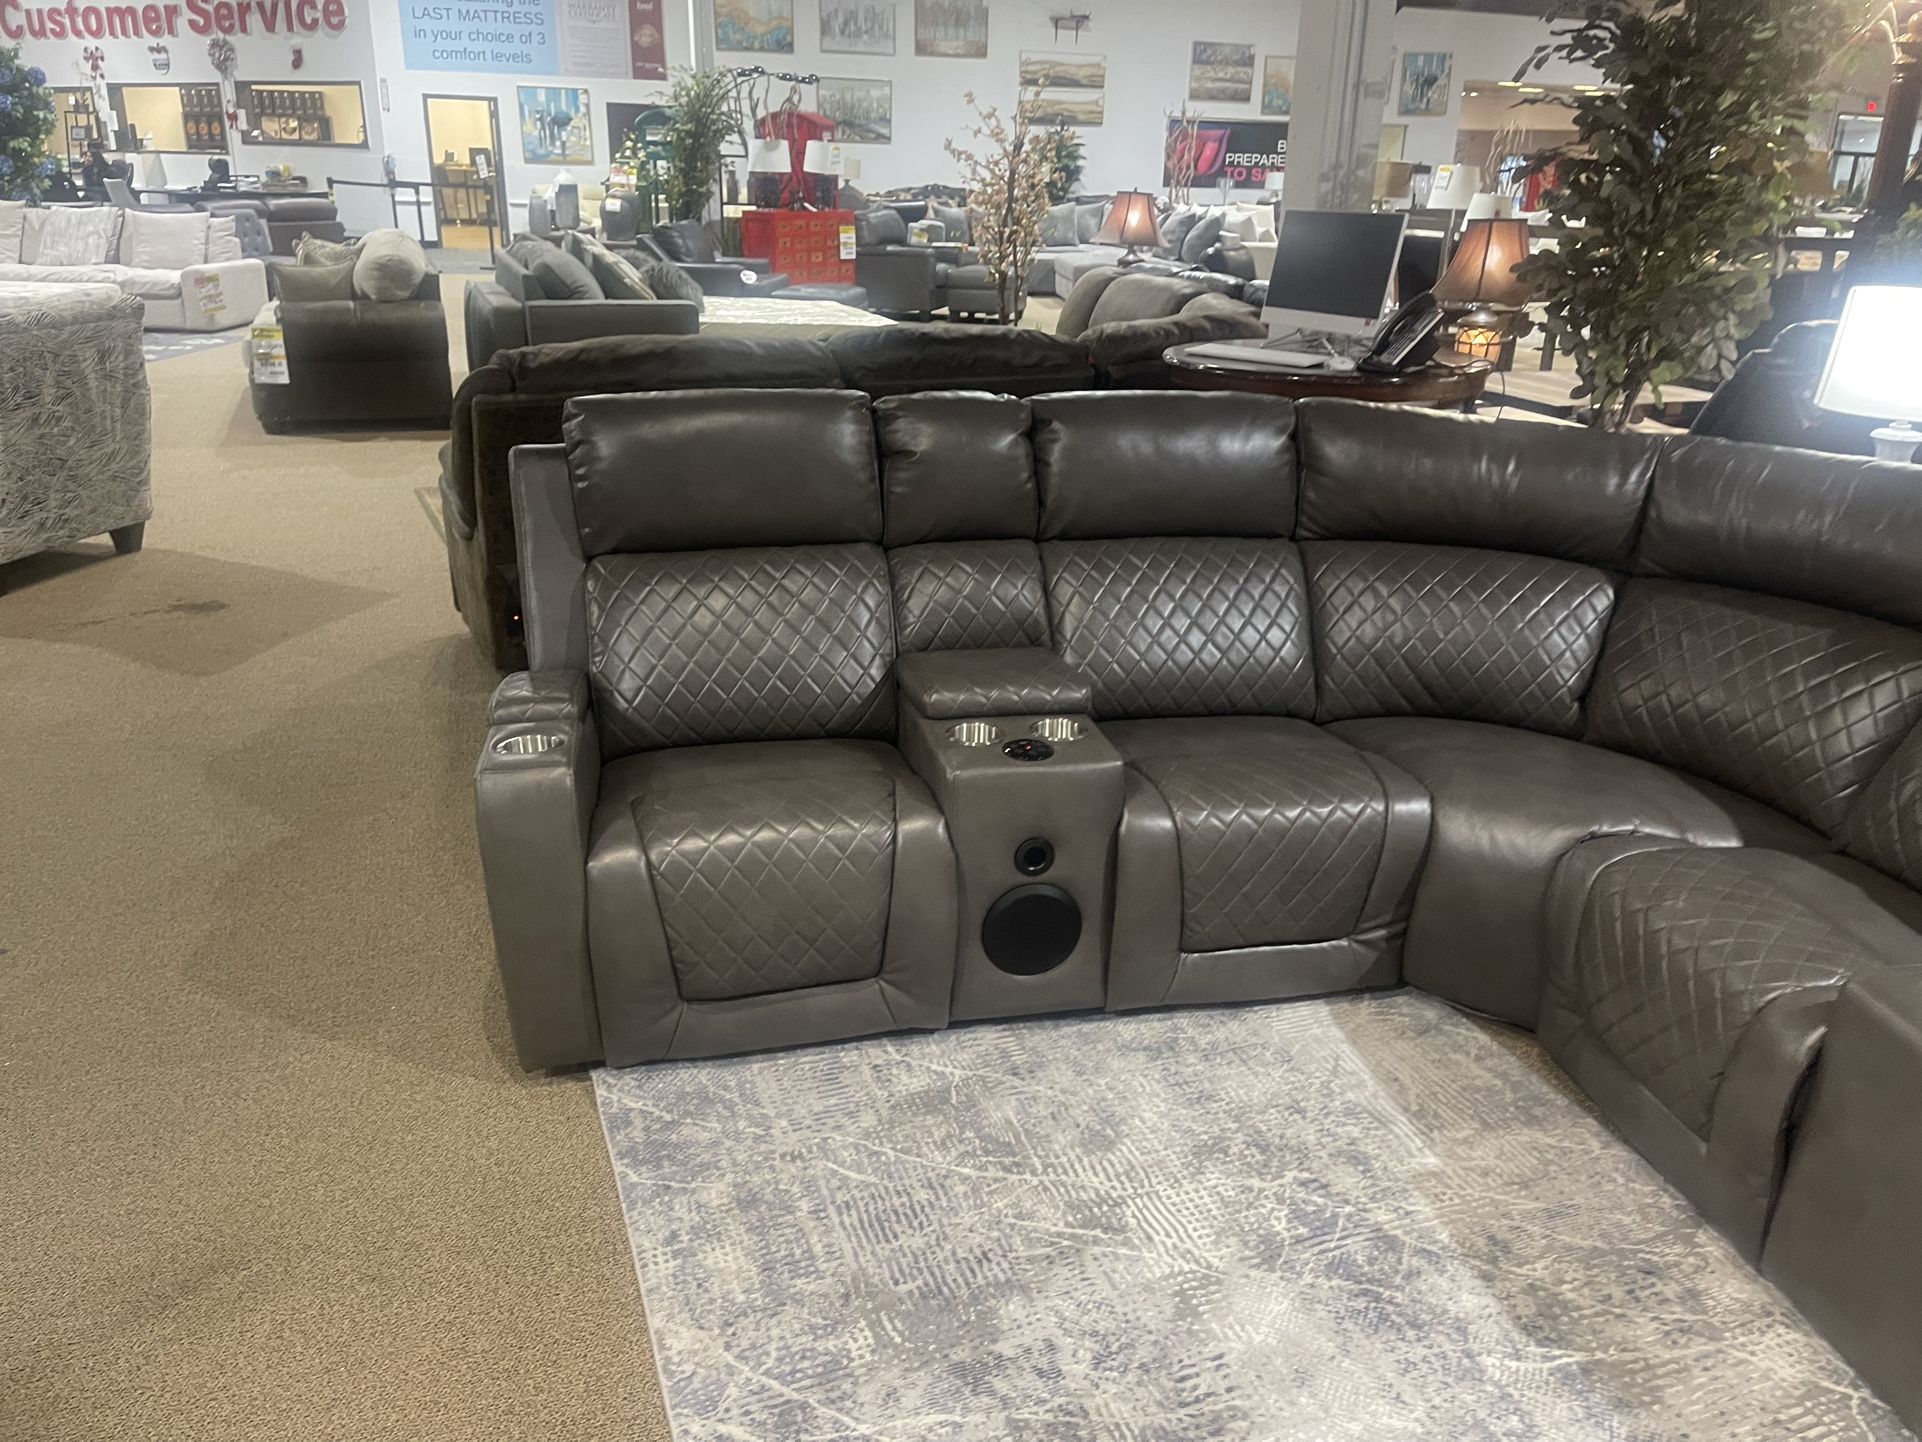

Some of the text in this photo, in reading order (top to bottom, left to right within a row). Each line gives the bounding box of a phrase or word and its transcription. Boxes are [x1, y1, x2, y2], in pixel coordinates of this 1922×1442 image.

[0, 0, 347, 39] Customer Service
[411, 6, 545, 26] LAST MATTRESS
[413, 25, 546, 45] in your choice of 3
[432, 47, 533, 64] comfort levels
[1224, 167, 1247, 181] TO
